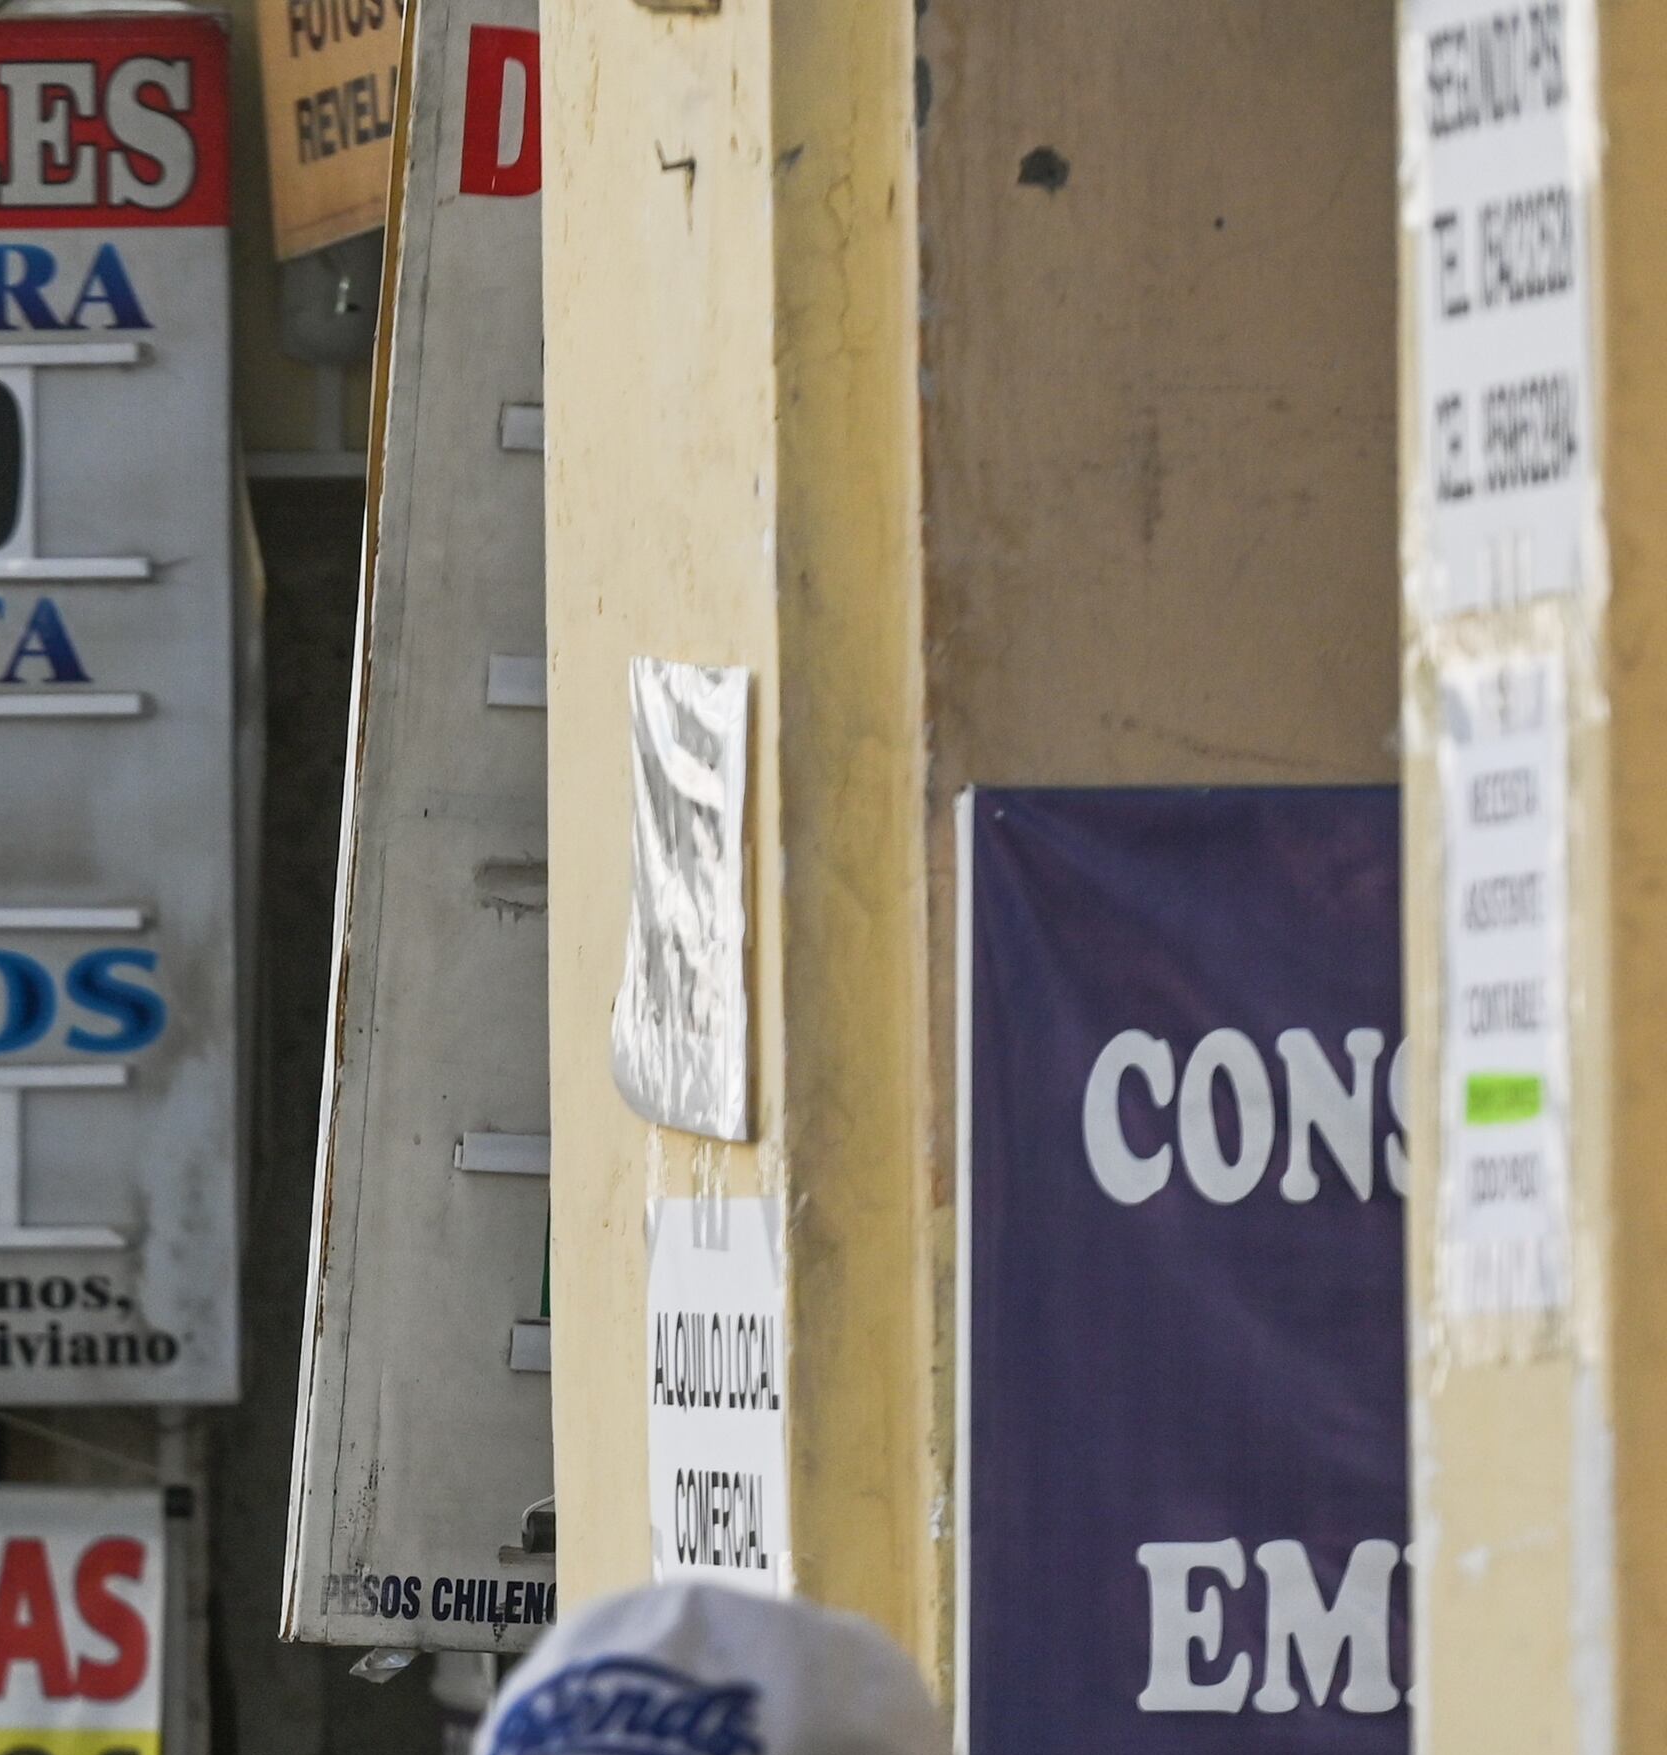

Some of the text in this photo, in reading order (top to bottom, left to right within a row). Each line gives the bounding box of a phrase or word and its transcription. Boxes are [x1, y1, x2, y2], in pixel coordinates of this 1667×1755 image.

[653, 1311, 780, 1412] ALQUILO LOCAL
[675, 1467, 768, 1570] COMERCIAL
[320, 1574, 422, 1621] PESOS
[1135, 1538, 1417, 1714] EM
